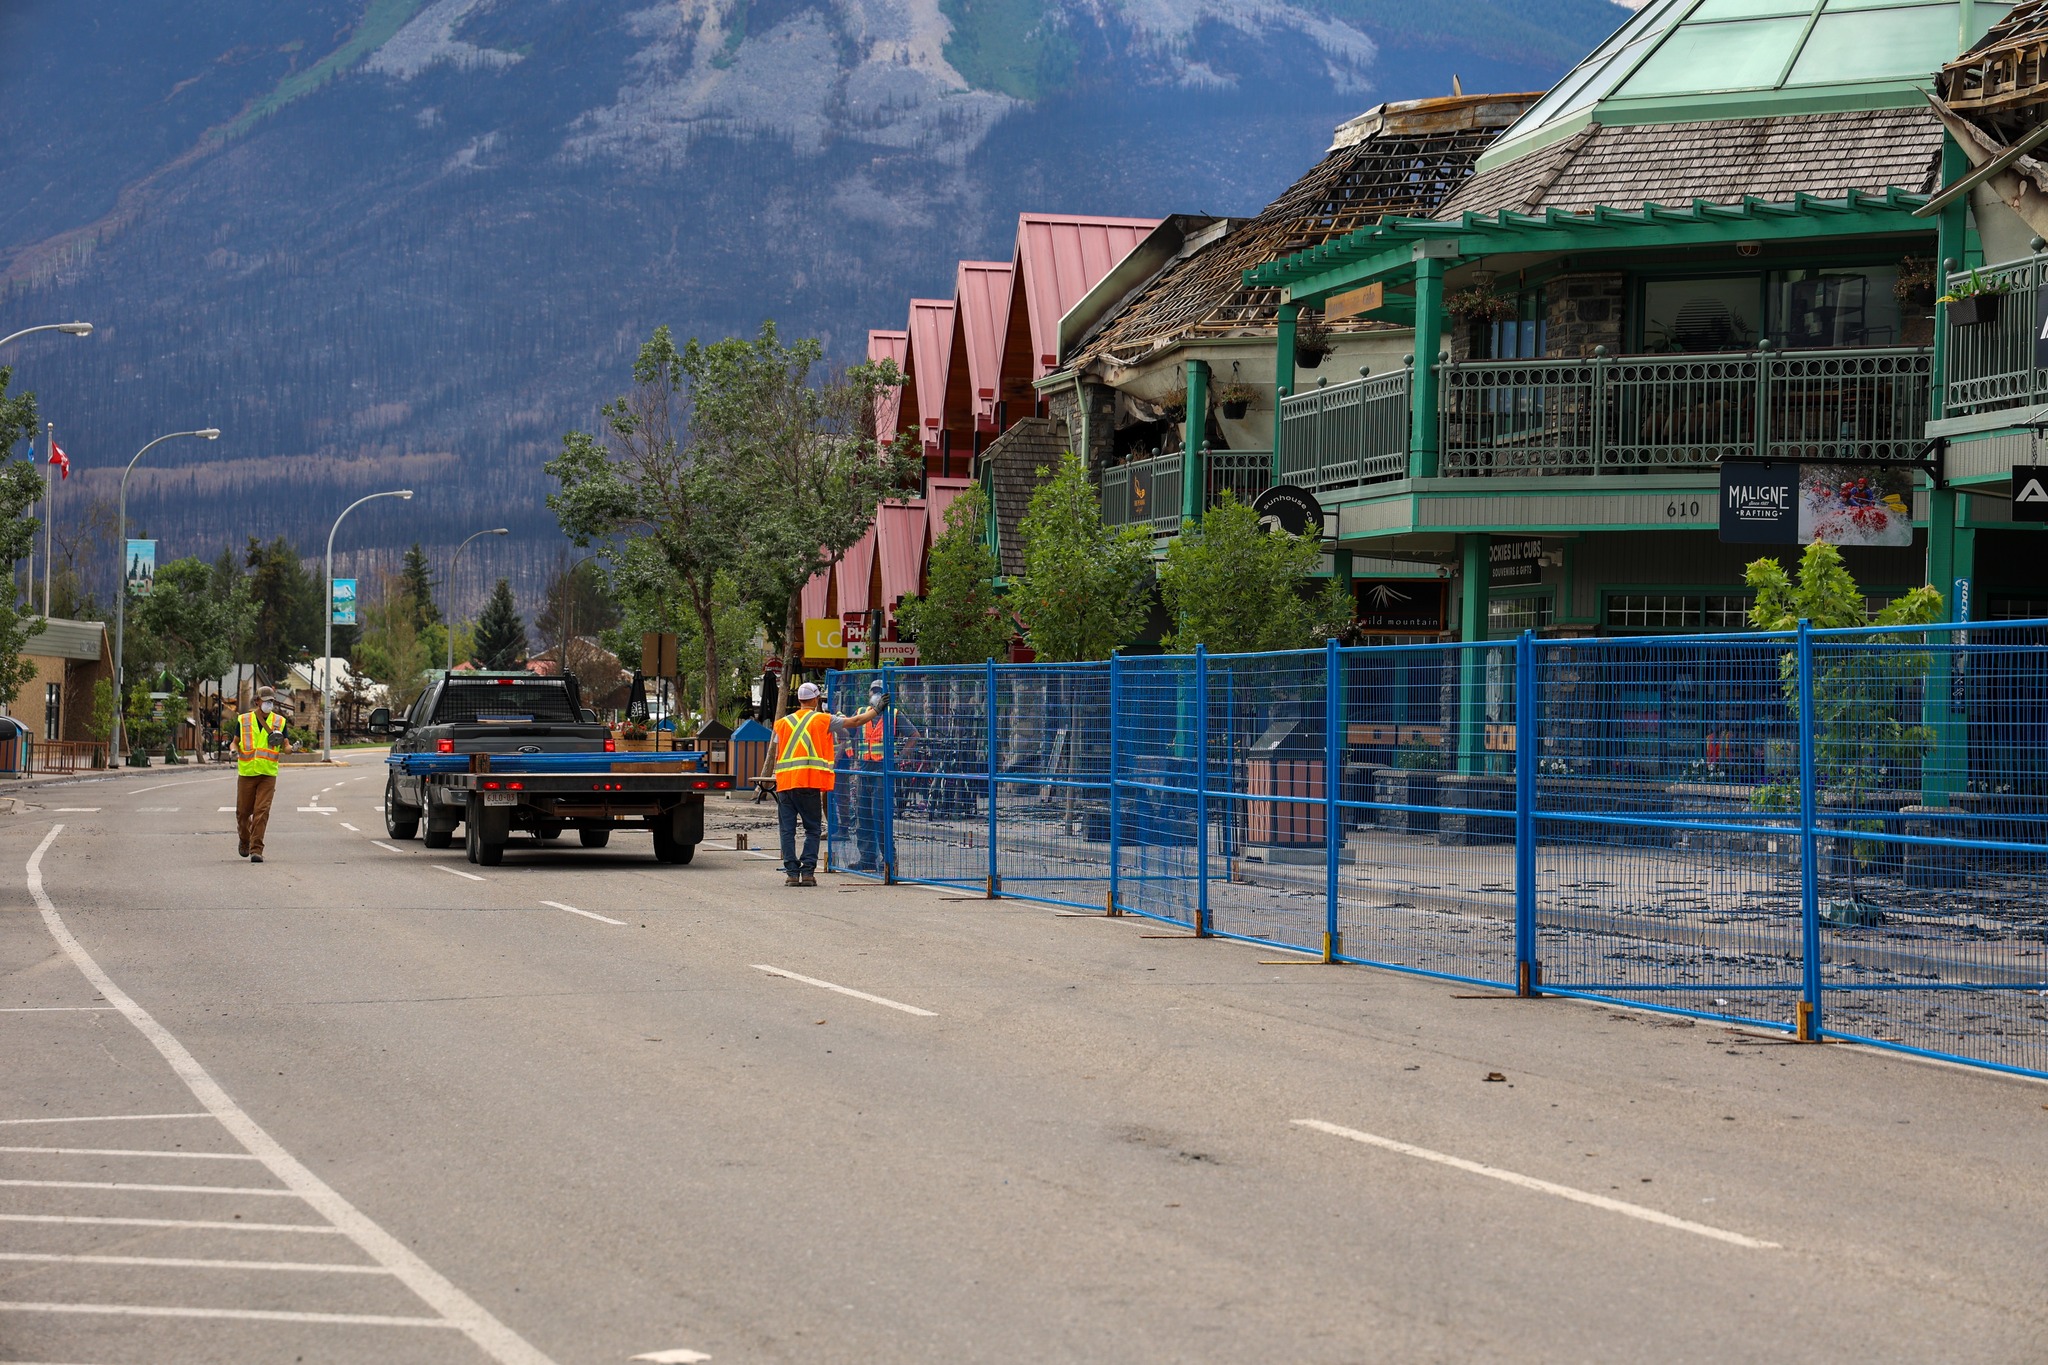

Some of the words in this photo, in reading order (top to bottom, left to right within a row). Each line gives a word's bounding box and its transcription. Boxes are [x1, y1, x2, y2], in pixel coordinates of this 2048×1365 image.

[1263, 494, 1307, 511] sunhouse
[1729, 485, 1790, 509] MALIGNE
[1666, 501, 1700, 518] 610
[1740, 509, 1778, 518] RAFTING
[1489, 543, 1512, 562] OCKIES
[1523, 540, 1541, 559] CUBS
[1360, 615, 1383, 626] wild
[1387, 617, 1439, 626] mountain
[865, 646, 916, 655] Parmacy
